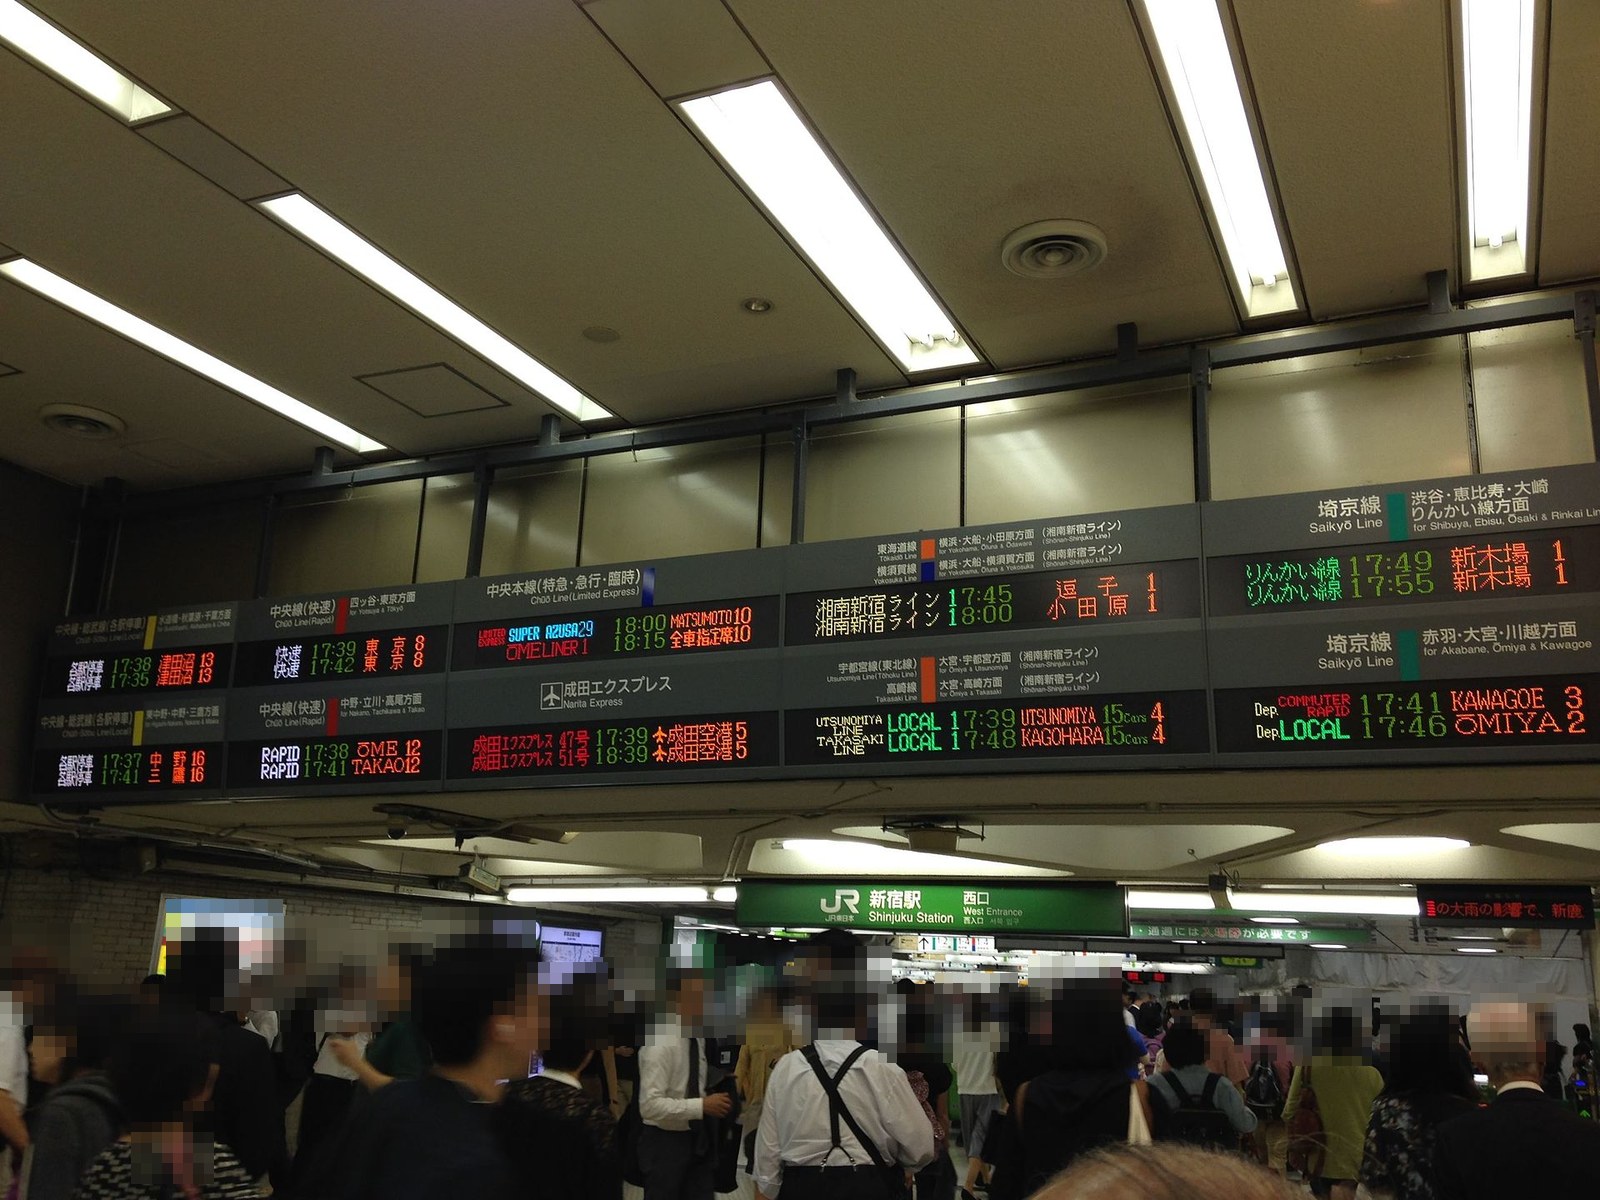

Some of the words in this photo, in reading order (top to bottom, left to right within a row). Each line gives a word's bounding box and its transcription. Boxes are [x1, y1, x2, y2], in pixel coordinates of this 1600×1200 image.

[1318, 495, 1381, 518] 埼京線
[1412, 496, 1530, 522] りんかい線方面
[1309, 520, 1352, 533] Saikyō
[1356, 518, 1383, 529] Line
[1413, 523, 1427, 532] for
[1430, 520, 1472, 531] Shibuya,
[1475, 517, 1505, 526] Ebisu,
[1551, 509, 1582, 520] Rinkai
[1451, 542, 1529, 569] 新木場
[1553, 540, 1565, 562] 1
[1246, 557, 1341, 586] りんかい線
[1351, 550, 1433, 577] 17:49
[1147, 572, 1156, 592] 1
[1453, 564, 1532, 593] 新木場
[1555, 563, 1568, 585] 1
[949, 584, 1013, 607] 17:45
[1247, 580, 1343, 607] りんかい線
[1351, 572, 1434, 599] 17:55
[815, 592, 940, 619] 湘南新宿ライン
[1148, 592, 1158, 613] 1
[614, 614, 666, 634] 18:00
[670, 609, 732, 629] MATSUMOTO
[815, 611, 940, 637] 湘南新宿ライン
[949, 604, 1013, 627] 18:00
[415, 634, 425, 651] 8
[508, 626, 540, 643] SUPER
[614, 632, 666, 652] 18:15
[1326, 633, 1392, 654] 埼京線
[275, 644, 302, 662] 快速
[311, 640, 357, 660] 17:39
[1423, 647, 1437, 656] for
[1441, 645, 1489, 655] Akabane,
[1530, 643, 1536, 651] &
[1540, 640, 1592, 651] Kawagoe
[112, 657, 151, 674] 17:38
[199, 652, 215, 668] 13
[310, 657, 354, 676] 17:42
[413, 651, 424, 668] 8
[1318, 657, 1362, 670] Saikyō
[1366, 656, 1394, 667] Line
[197, 668, 212, 684] 13
[273, 661, 300, 679] 快速
[110, 673, 150, 689] 17:35
[564, 676, 672, 697] 成田エクスプレス
[564, 699, 587, 709] Narita
[590, 698, 623, 708] Express
[1278, 693, 1351, 708] COMMUTER
[1360, 691, 1441, 717] 17:41
[1450, 686, 1546, 712] KAWAGOE
[1565, 685, 1584, 710] 3
[950, 708, 1016, 731] 17:39
[1021, 705, 1097, 727] UTSUNOMIYA
[1151, 701, 1166, 722] 4
[1254, 702, 1279, 719] Dep.
[1307, 705, 1350, 718] RAPID
[735, 721, 747, 741] 5
[816, 714, 883, 728] UTSUNOMIYA
[833, 725, 863, 737] LINE
[887, 711, 942, 733] LOCAL
[1279, 718, 1351, 741] LOCAL
[1361, 713, 1447, 739] 17:46
[1567, 710, 1586, 734] 2
[596, 727, 648, 747] 17:39
[816, 734, 884, 747] TAKASAKI
[888, 732, 943, 753] LOCAL
[951, 729, 1017, 751] 17:48
[1021, 726, 1104, 748] KAGOHARA
[1151, 722, 1166, 745] 4
[261, 745, 301, 763] RAPID
[304, 743, 349, 761] 17:38
[405, 739, 422, 757] 12
[596, 745, 648, 765] 18:39
[735, 741, 747, 760] 5
[833, 745, 865, 756] LINE
[102, 752, 143, 769] 17:37
[191, 750, 206, 767] 16
[101, 768, 140, 785] 17:41
[189, 767, 205, 783] 16
[260, 762, 299, 780] RAPID
[303, 760, 347, 778] 17:41
[820, 889, 860, 914] JR
[869, 889, 922, 909] 新宿駅
[963, 890, 989, 906] 西口
[869, 911, 913, 925] Shinjuku
[916, 912, 954, 923] Station
[963, 906, 984, 916] West
[986, 907, 1023, 916] Entrance
